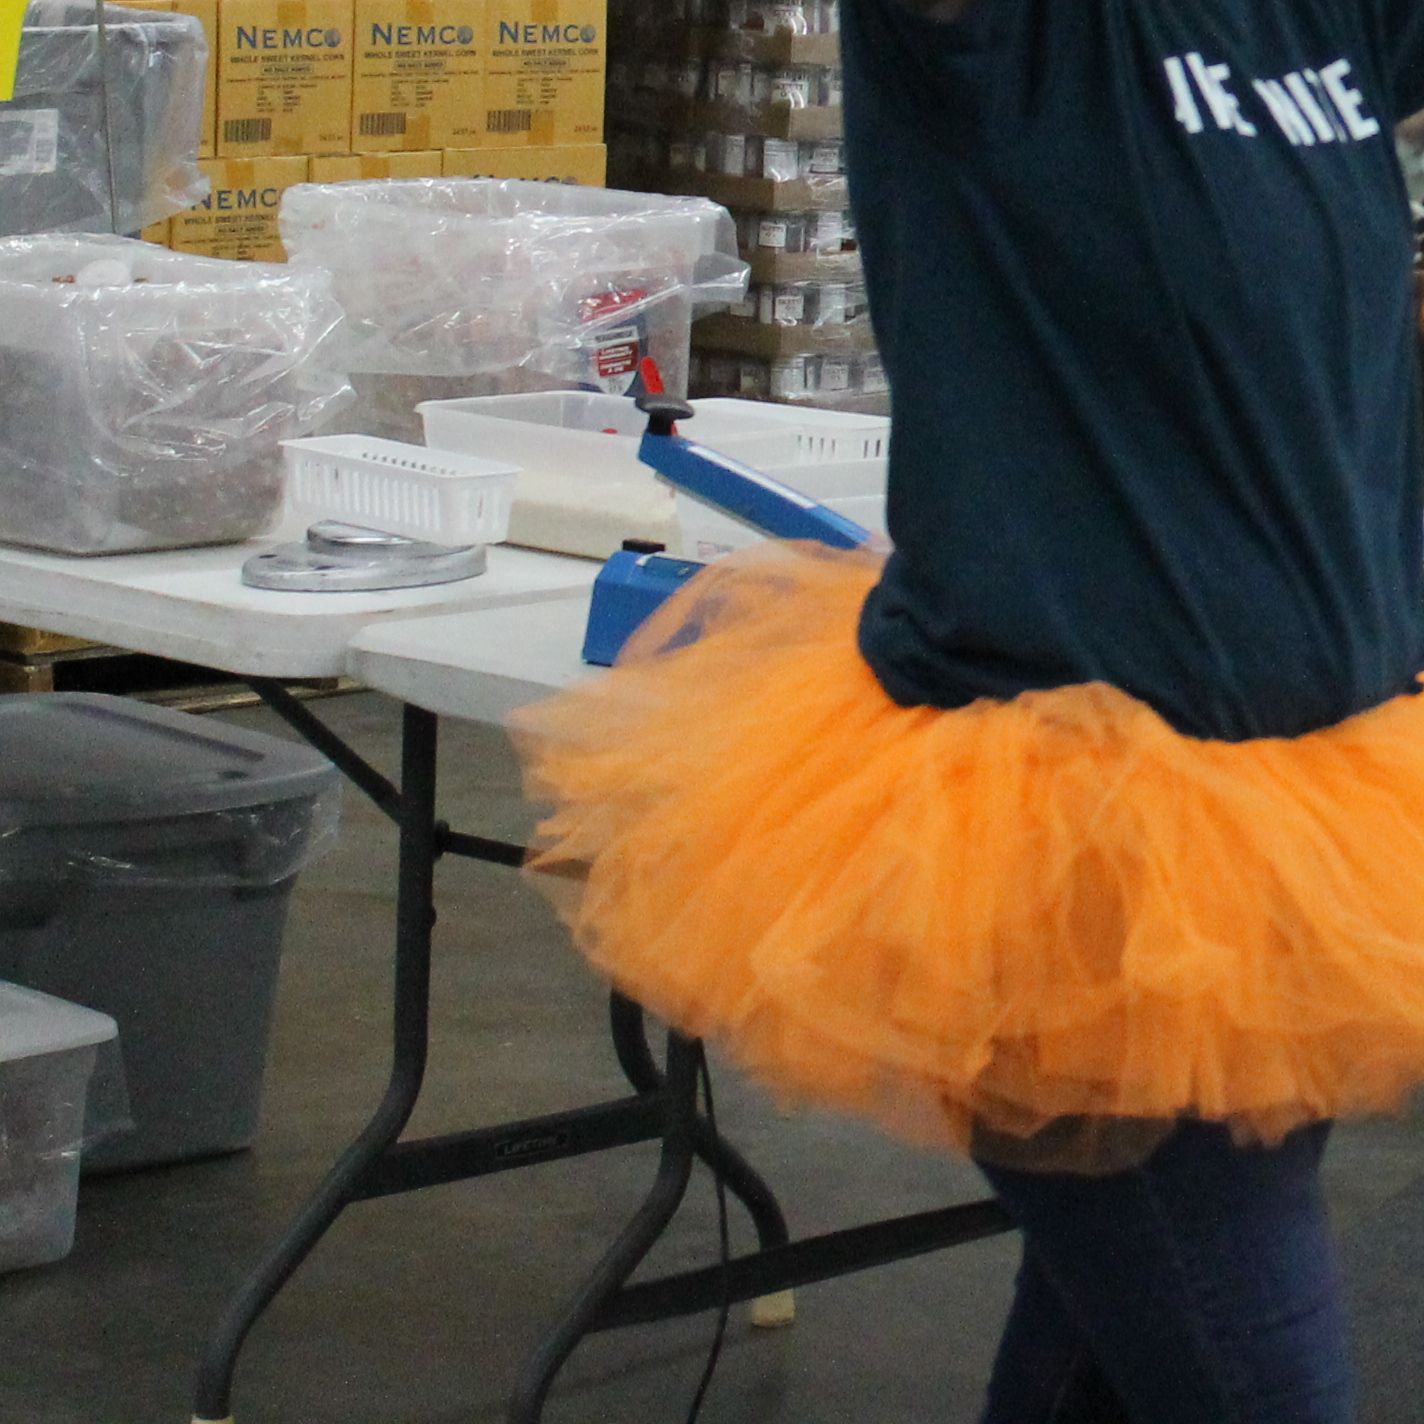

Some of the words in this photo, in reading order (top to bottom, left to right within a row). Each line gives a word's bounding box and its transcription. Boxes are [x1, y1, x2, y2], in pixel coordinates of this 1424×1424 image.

[237, 26, 341, 49] NEMCO
[371, 23, 473, 46] NEMCO
[499, 21, 596, 44] NEMCO
[191, 187, 279, 211] NEMC
